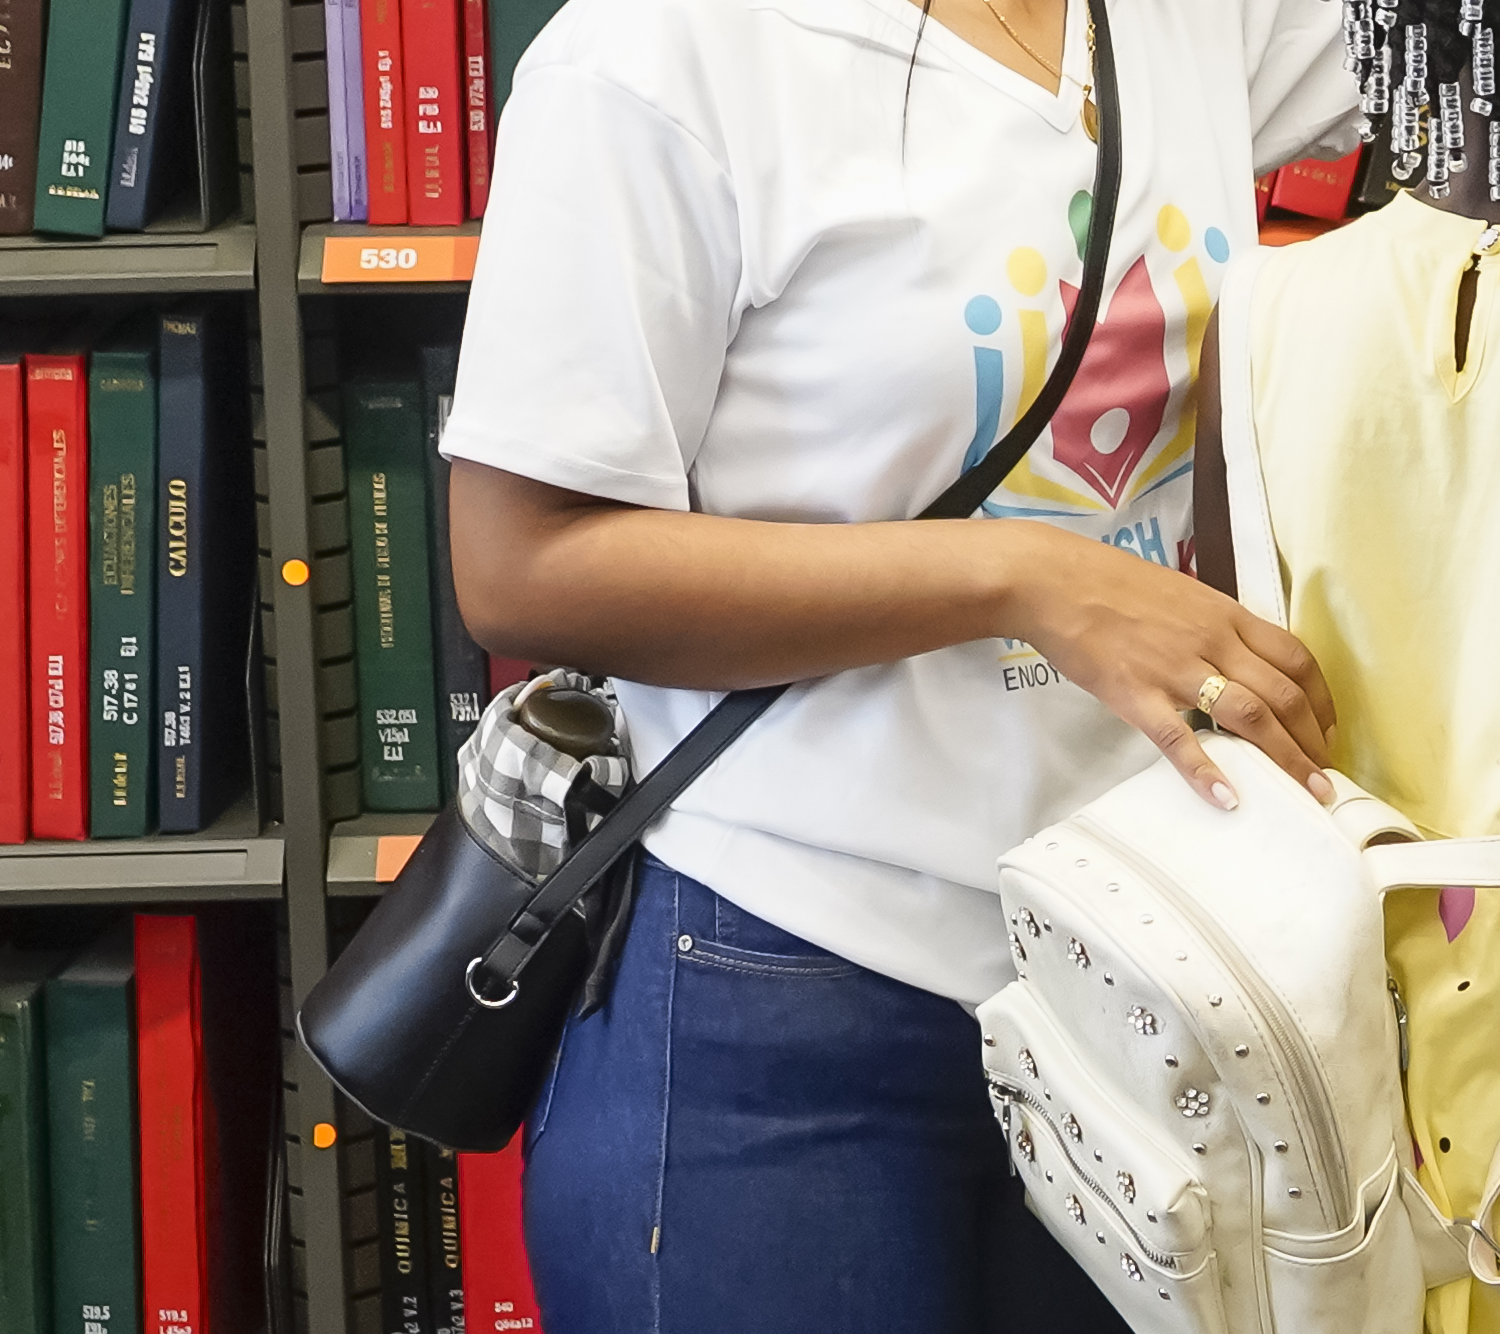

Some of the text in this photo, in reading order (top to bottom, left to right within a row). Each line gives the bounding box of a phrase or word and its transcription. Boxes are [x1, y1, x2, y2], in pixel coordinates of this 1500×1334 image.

[360, 248, 418, 269] 530
[168, 479, 191, 577] CALCULO
[1003, 661, 1068, 692] ENJOY
[392, 1182, 411, 1274] QUIMICA
[438, 1177, 460, 1269] QUIMICA
